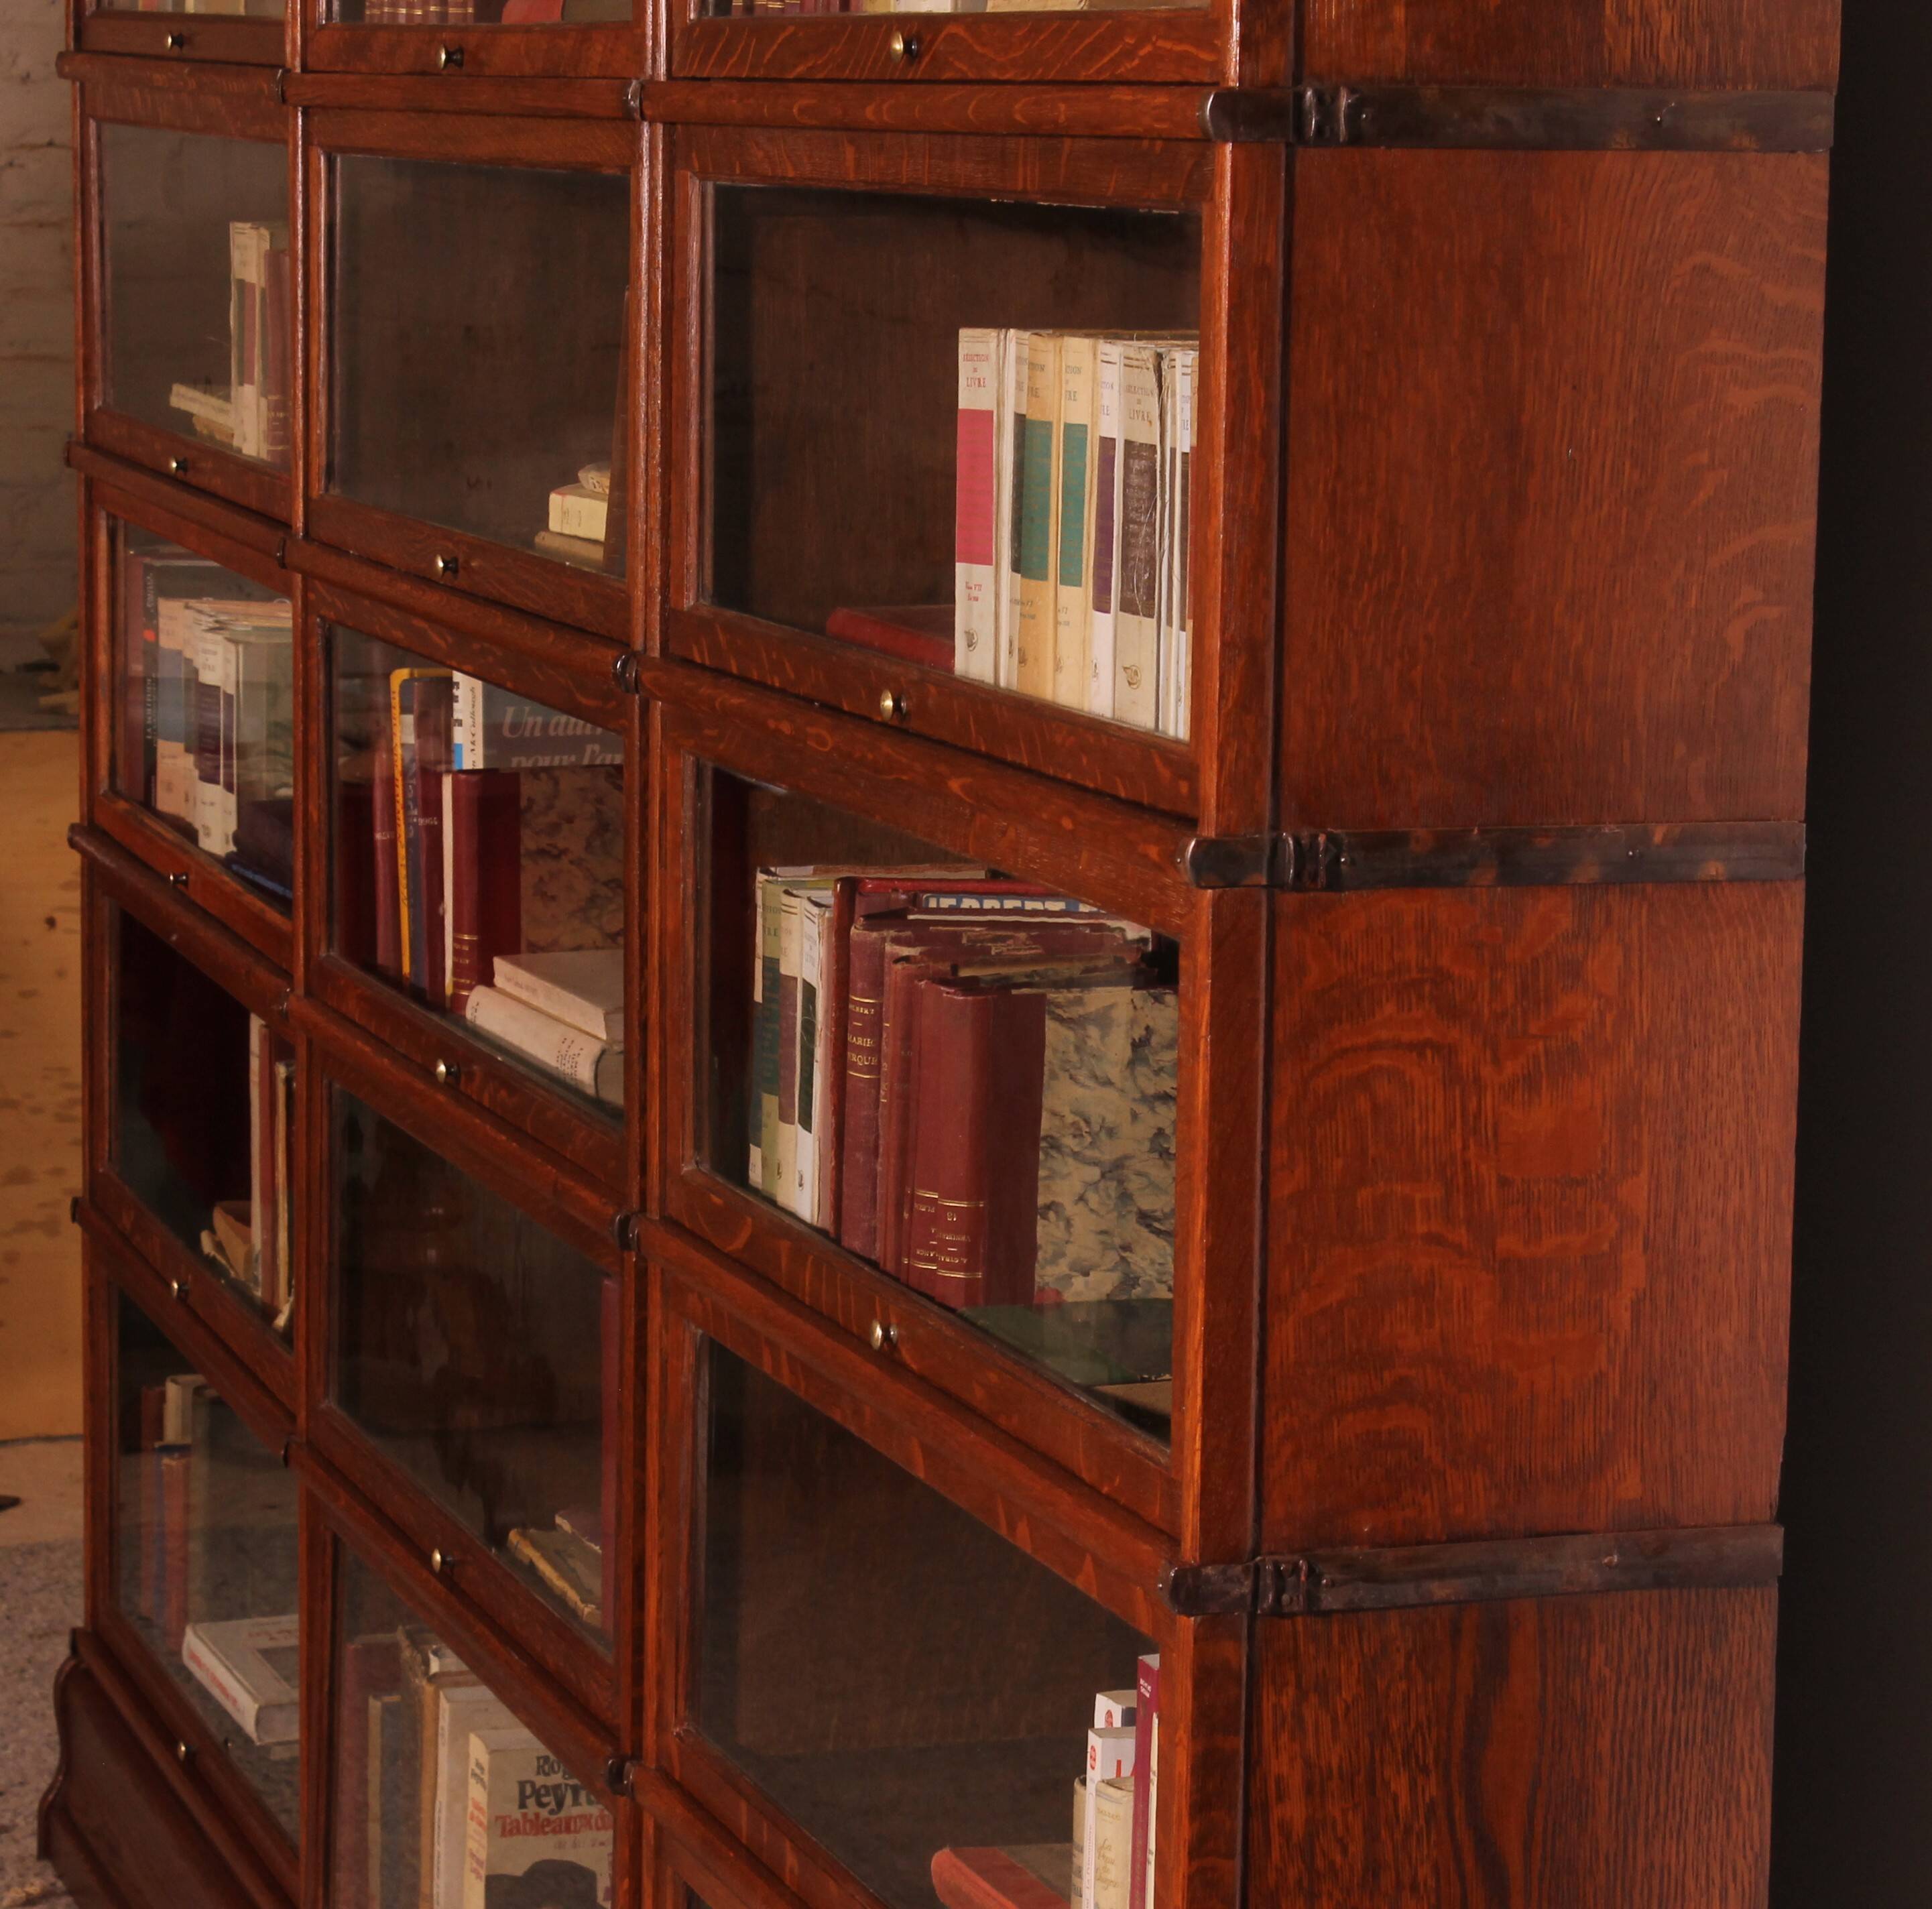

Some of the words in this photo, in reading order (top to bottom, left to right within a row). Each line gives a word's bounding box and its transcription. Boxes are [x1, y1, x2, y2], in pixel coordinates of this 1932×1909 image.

[966, 377, 987, 388] LIVRE
[502, 705, 543, 738] Un
[495, 1812, 593, 1838] Tableaux
